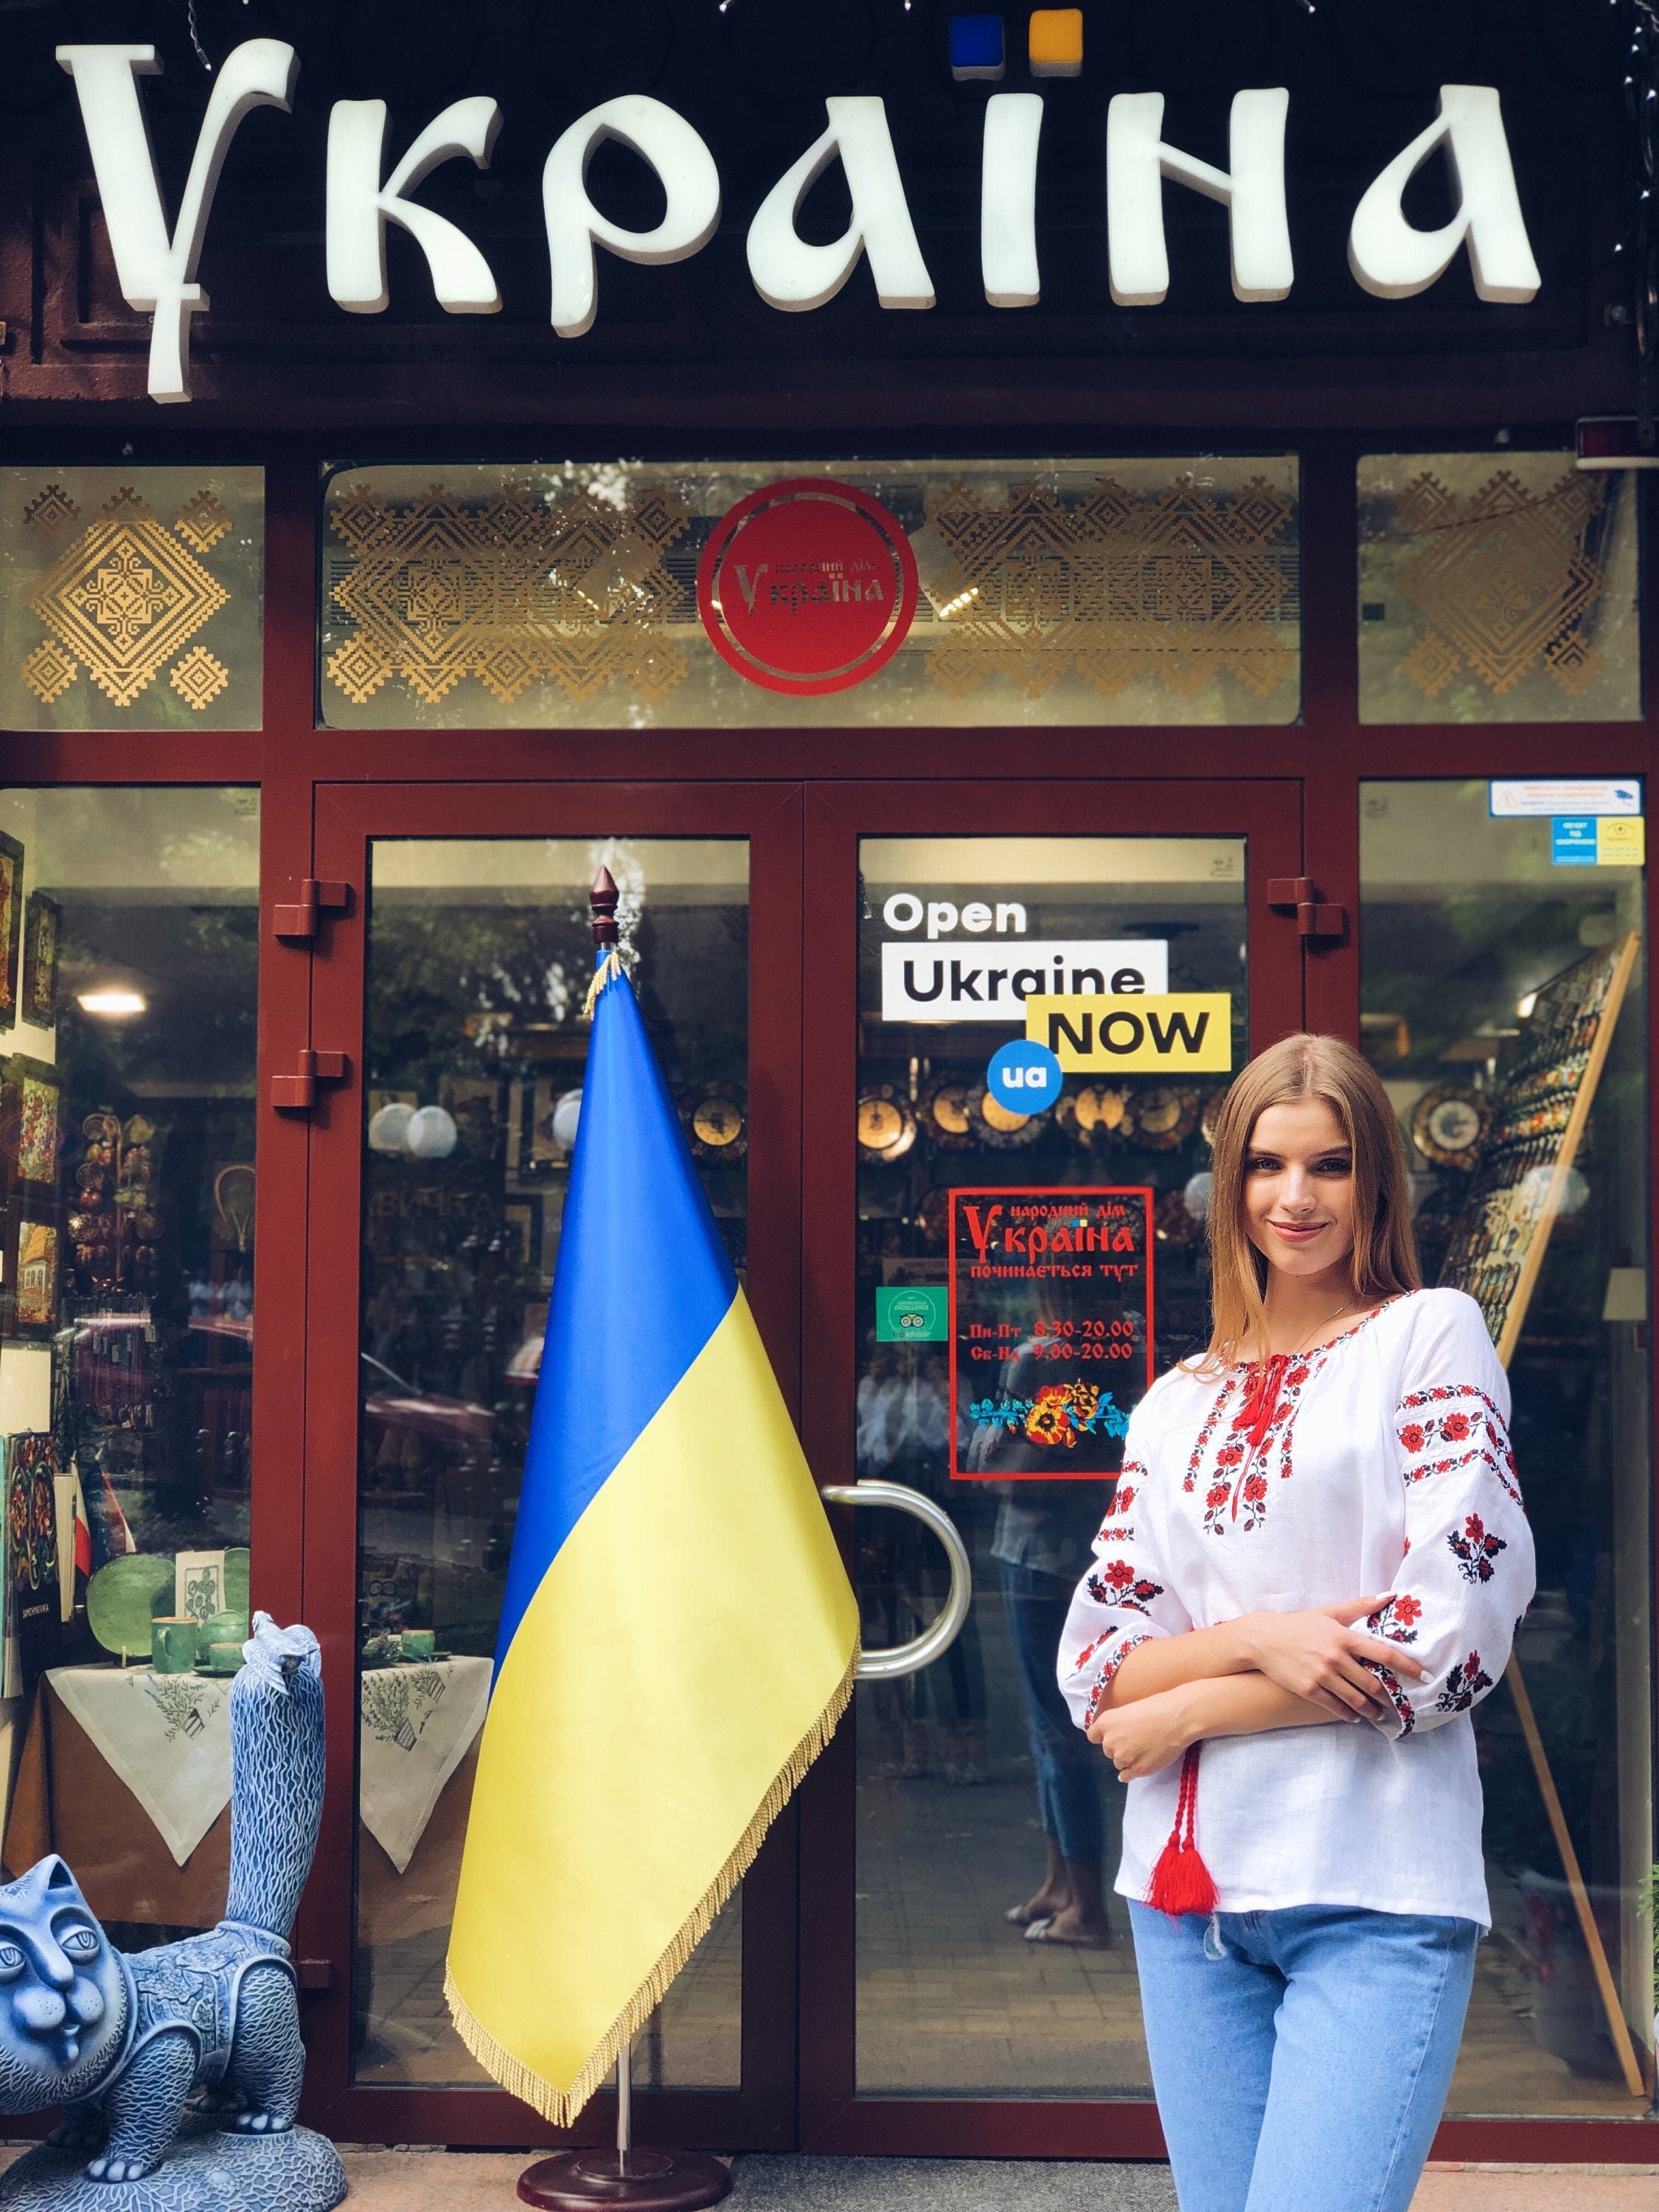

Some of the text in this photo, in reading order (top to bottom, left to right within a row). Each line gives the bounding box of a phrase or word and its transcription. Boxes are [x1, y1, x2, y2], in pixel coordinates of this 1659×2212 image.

[55, 8, 1542, 403] Україна
[734, 563, 884, 615] Україна
[883, 893, 1027, 939] Open
[903, 954, 1145, 1002] Ukraine
[1048, 1011, 1210, 1055] NOW
[1002, 1066, 1048, 1088] ua
[1011, 1202, 1127, 1220] народний дім
[963, 1205, 1135, 1264] Україна
[970, 1264, 1139, 1282] починається тут
[1034, 1320, 1134, 1338] 8.30-20.00
[1034, 1342, 1133, 1360] 9.00-20.00
